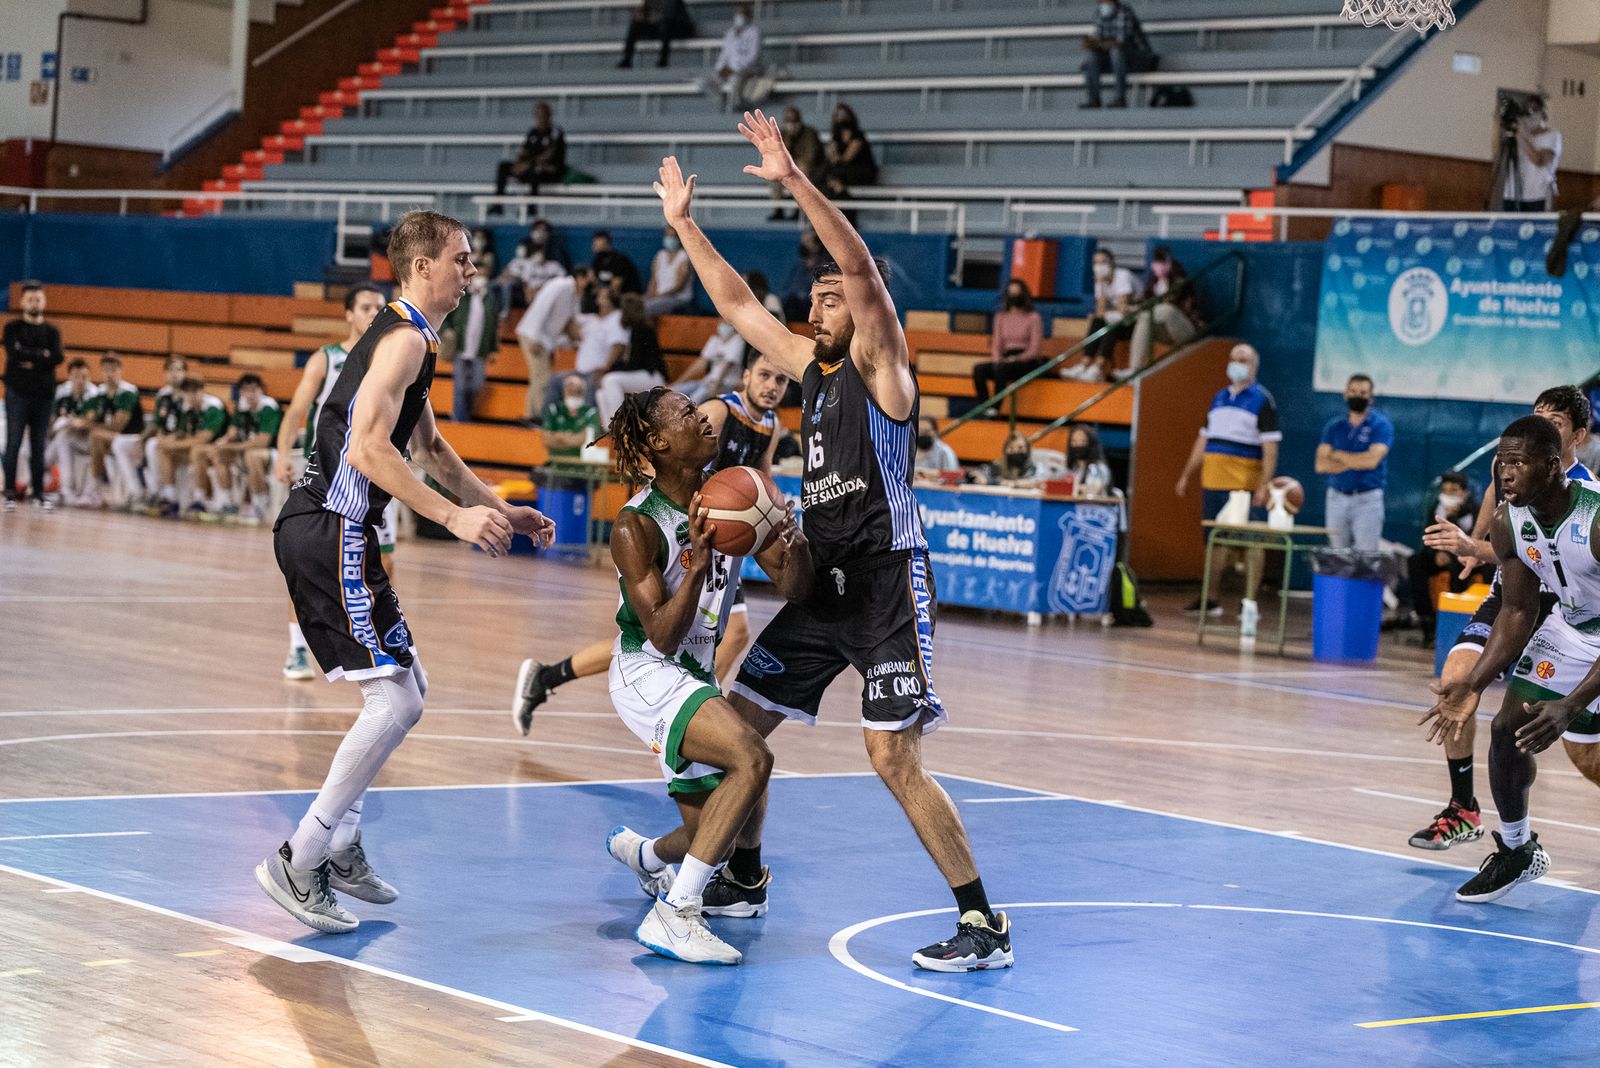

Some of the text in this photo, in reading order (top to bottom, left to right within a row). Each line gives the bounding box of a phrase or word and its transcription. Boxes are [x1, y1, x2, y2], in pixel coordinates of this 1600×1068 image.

[1449, 277, 1563, 298] Ayuntamiento
[1479, 296, 1561, 316] de Huelva
[807, 431, 825, 473] 16
[803, 472, 842, 495] HUELVA
[819, 477, 867, 503] SALUDA
[344, 515, 367, 580] BENIT
[946, 528, 1034, 556] de Huelva
[911, 557, 932, 623] UELVA
[748, 646, 774, 669] Ford
[873, 660, 916, 677] GARBANZO
[868, 676, 921, 701] DE ORO
